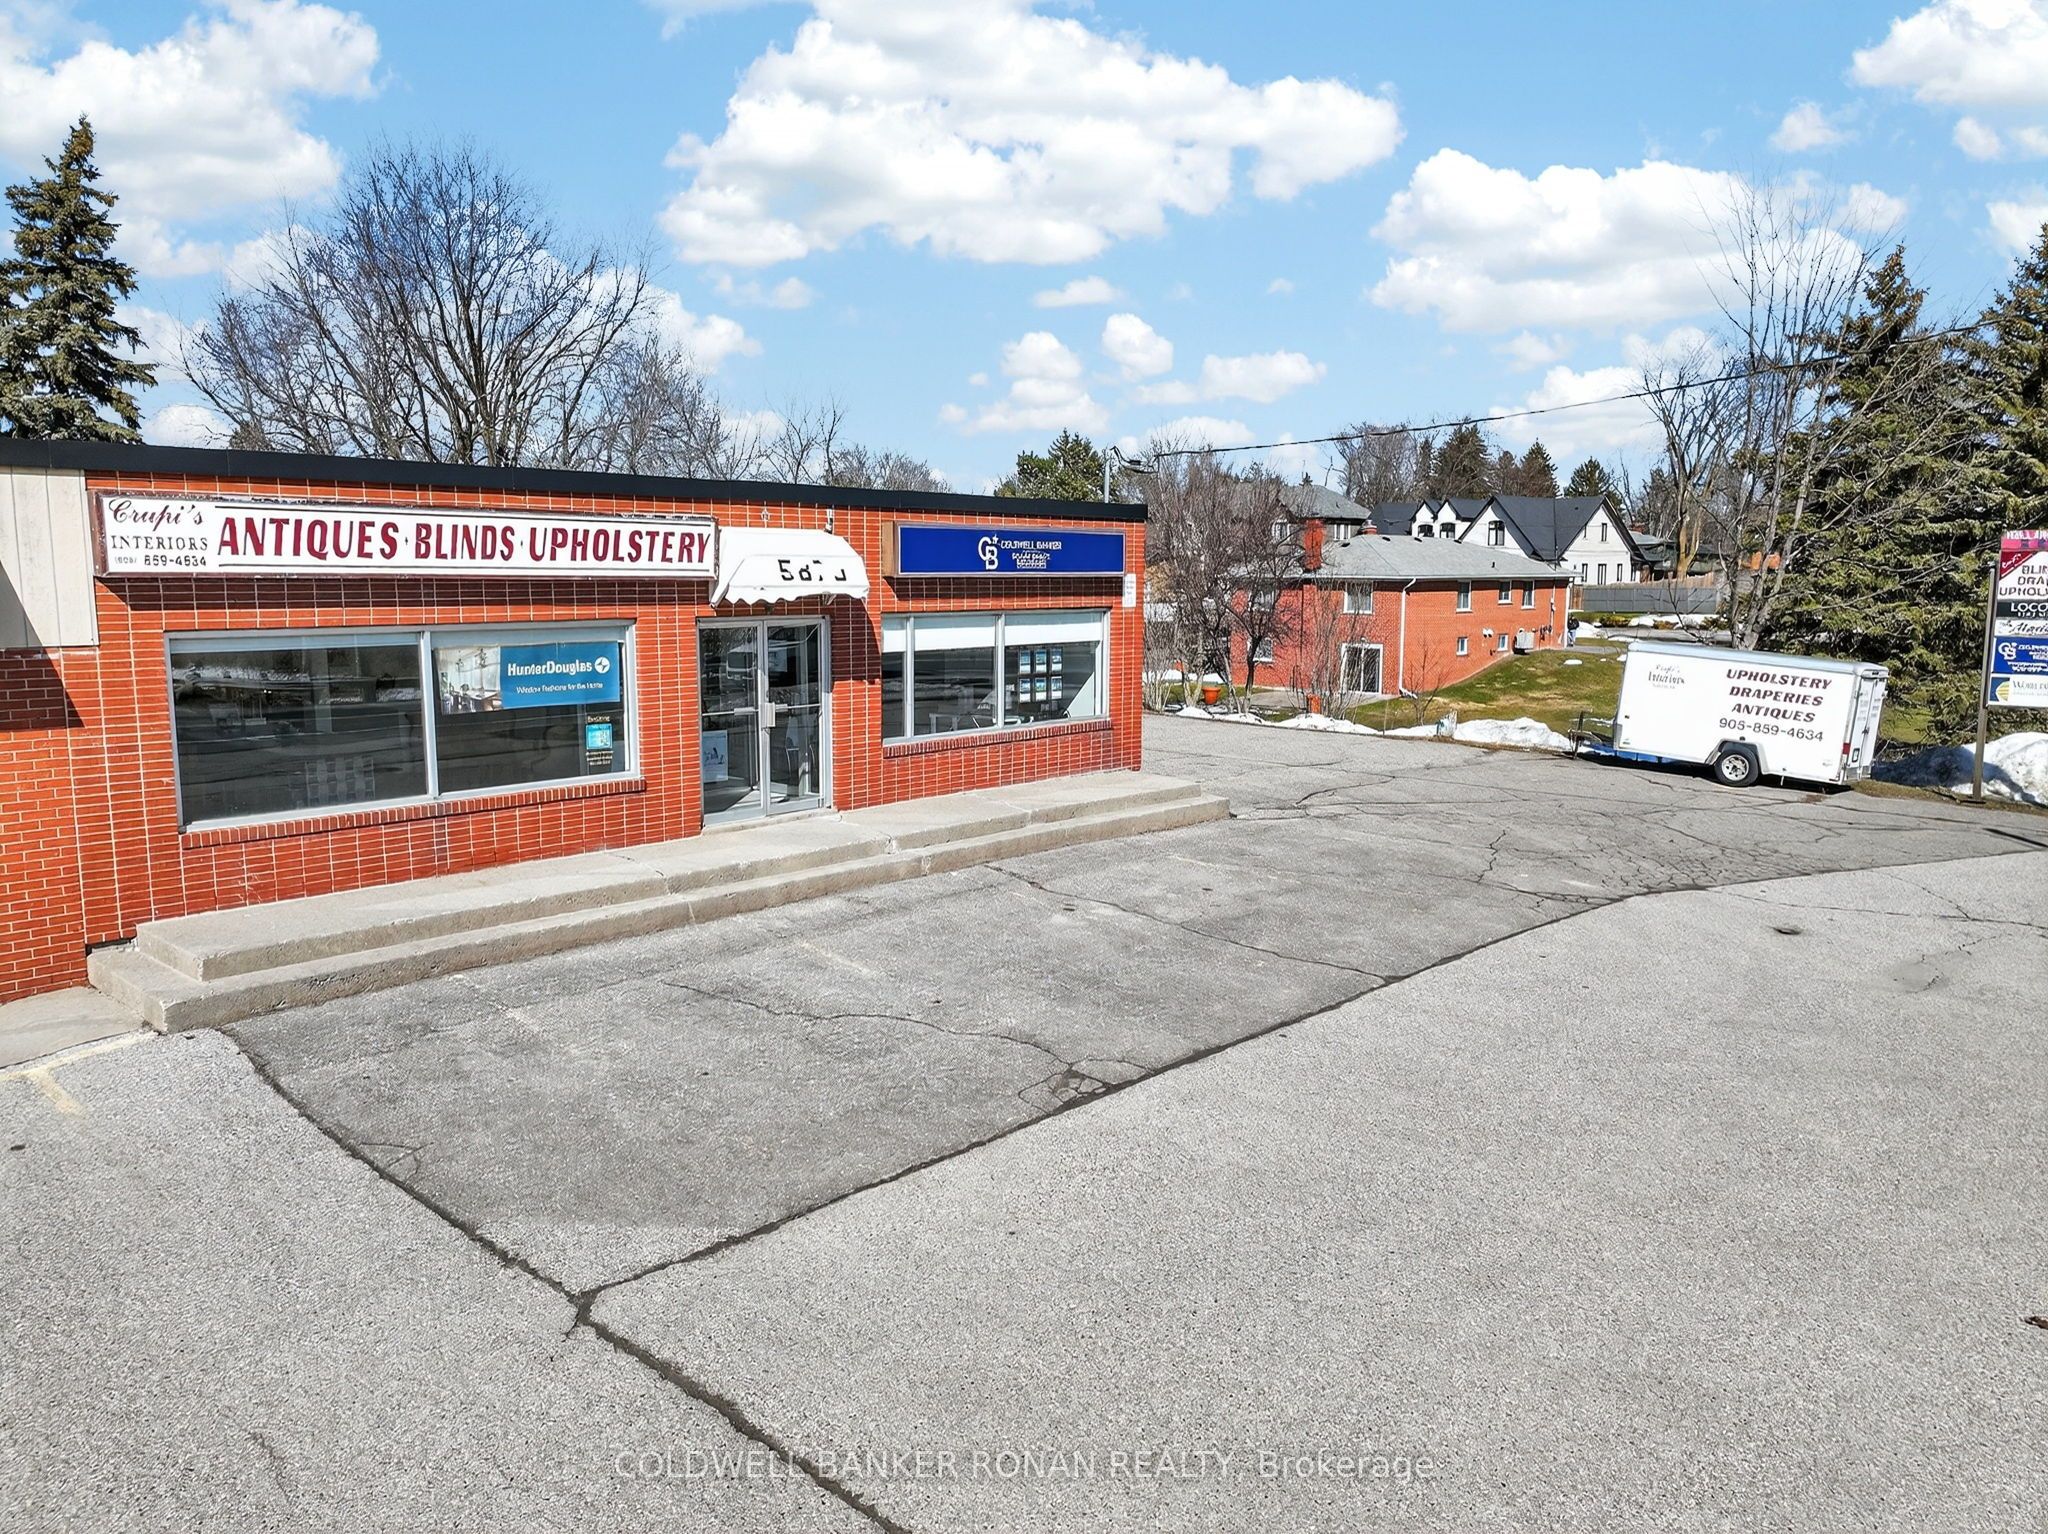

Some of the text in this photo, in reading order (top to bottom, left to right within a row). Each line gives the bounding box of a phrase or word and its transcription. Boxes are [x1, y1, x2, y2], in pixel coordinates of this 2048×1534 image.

[109, 499, 203, 532] Crupi's
[111, 535, 208, 551] INTERIORS
[217, 517, 711, 563] ANTIQUES BLINDS UPHOLSTERY
[2018, 575, 2048, 586] DRA
[1999, 586, 2048, 597] UPHOL
[508, 659, 593, 677] HunterDouglas
[1726, 668, 1832, 690] UPHOLSTERY
[1729, 686, 1824, 706] DRAPERIES
[1731, 703, 1816, 723] ANTIQUES
[1719, 717, 1824, 742] 905-859-4634
